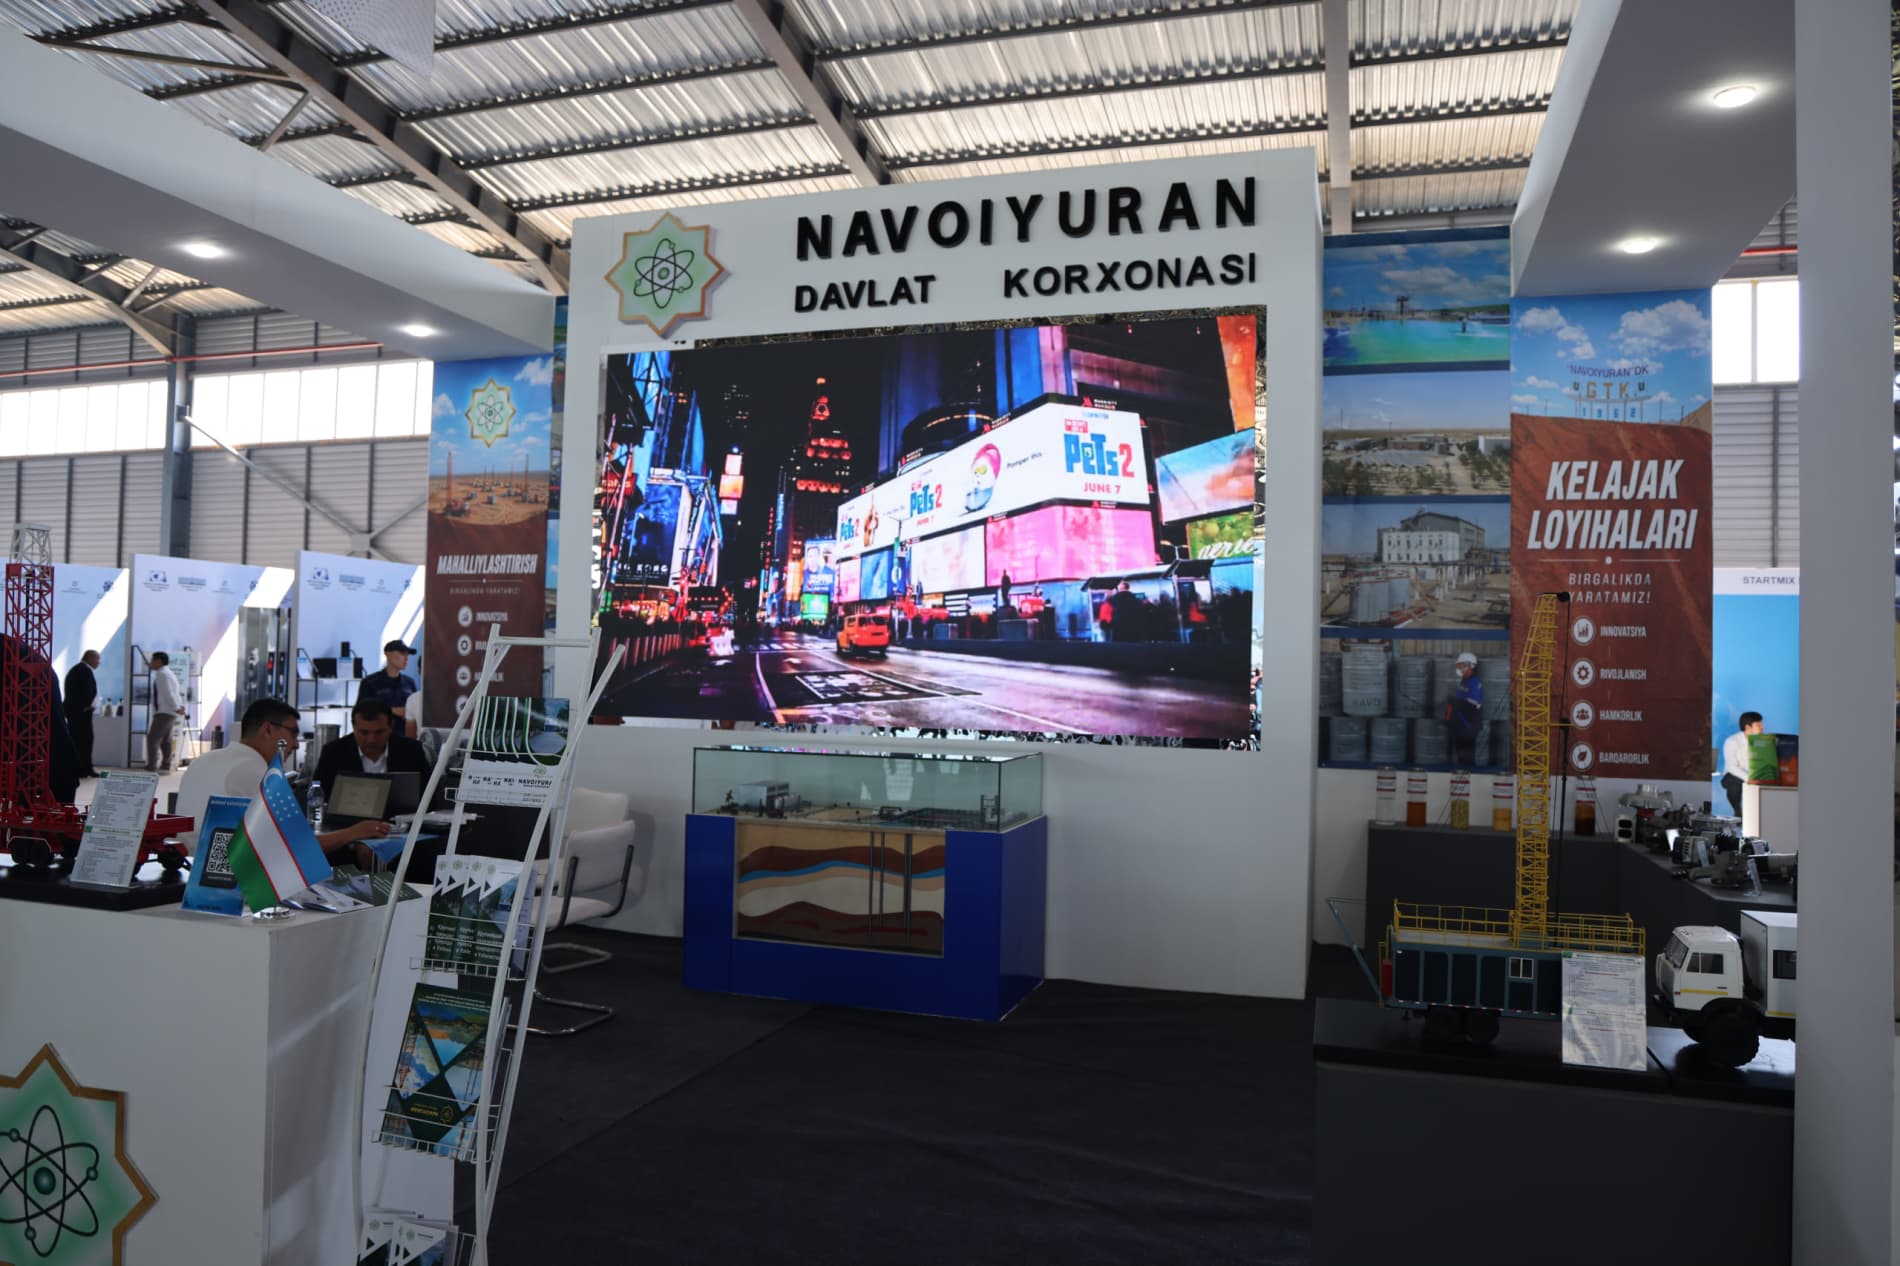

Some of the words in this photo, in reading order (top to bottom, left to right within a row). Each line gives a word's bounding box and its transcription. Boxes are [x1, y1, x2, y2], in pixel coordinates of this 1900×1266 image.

[797, 176, 1256, 260] NAVOIYURAN
[794, 275, 936, 312] DAVLAT
[1003, 252, 1256, 298] KORXONASI
[1118, 443, 1135, 478] 2
[1084, 482, 1112, 494] JUNE
[1115, 484, 1121, 495] 7
[1545, 459, 1685, 501] KELAJAK
[935, 483, 943, 508] 2
[1527, 508, 1699, 550] LOYIHALARI
[436, 554, 538, 575] MAHALLIYLASHTIRISH
[1568, 572, 1652, 585] BIRGALIKDA
[1742, 575, 1796, 585] STARTMIX
[1568, 591, 1652, 604] YARATAMIZ!
[1600, 626, 1647, 637] INNOVATSIYA
[1600, 668, 1647, 680] RIVOJLANISH
[1600, 710, 1642, 721] HAMKORLIK
